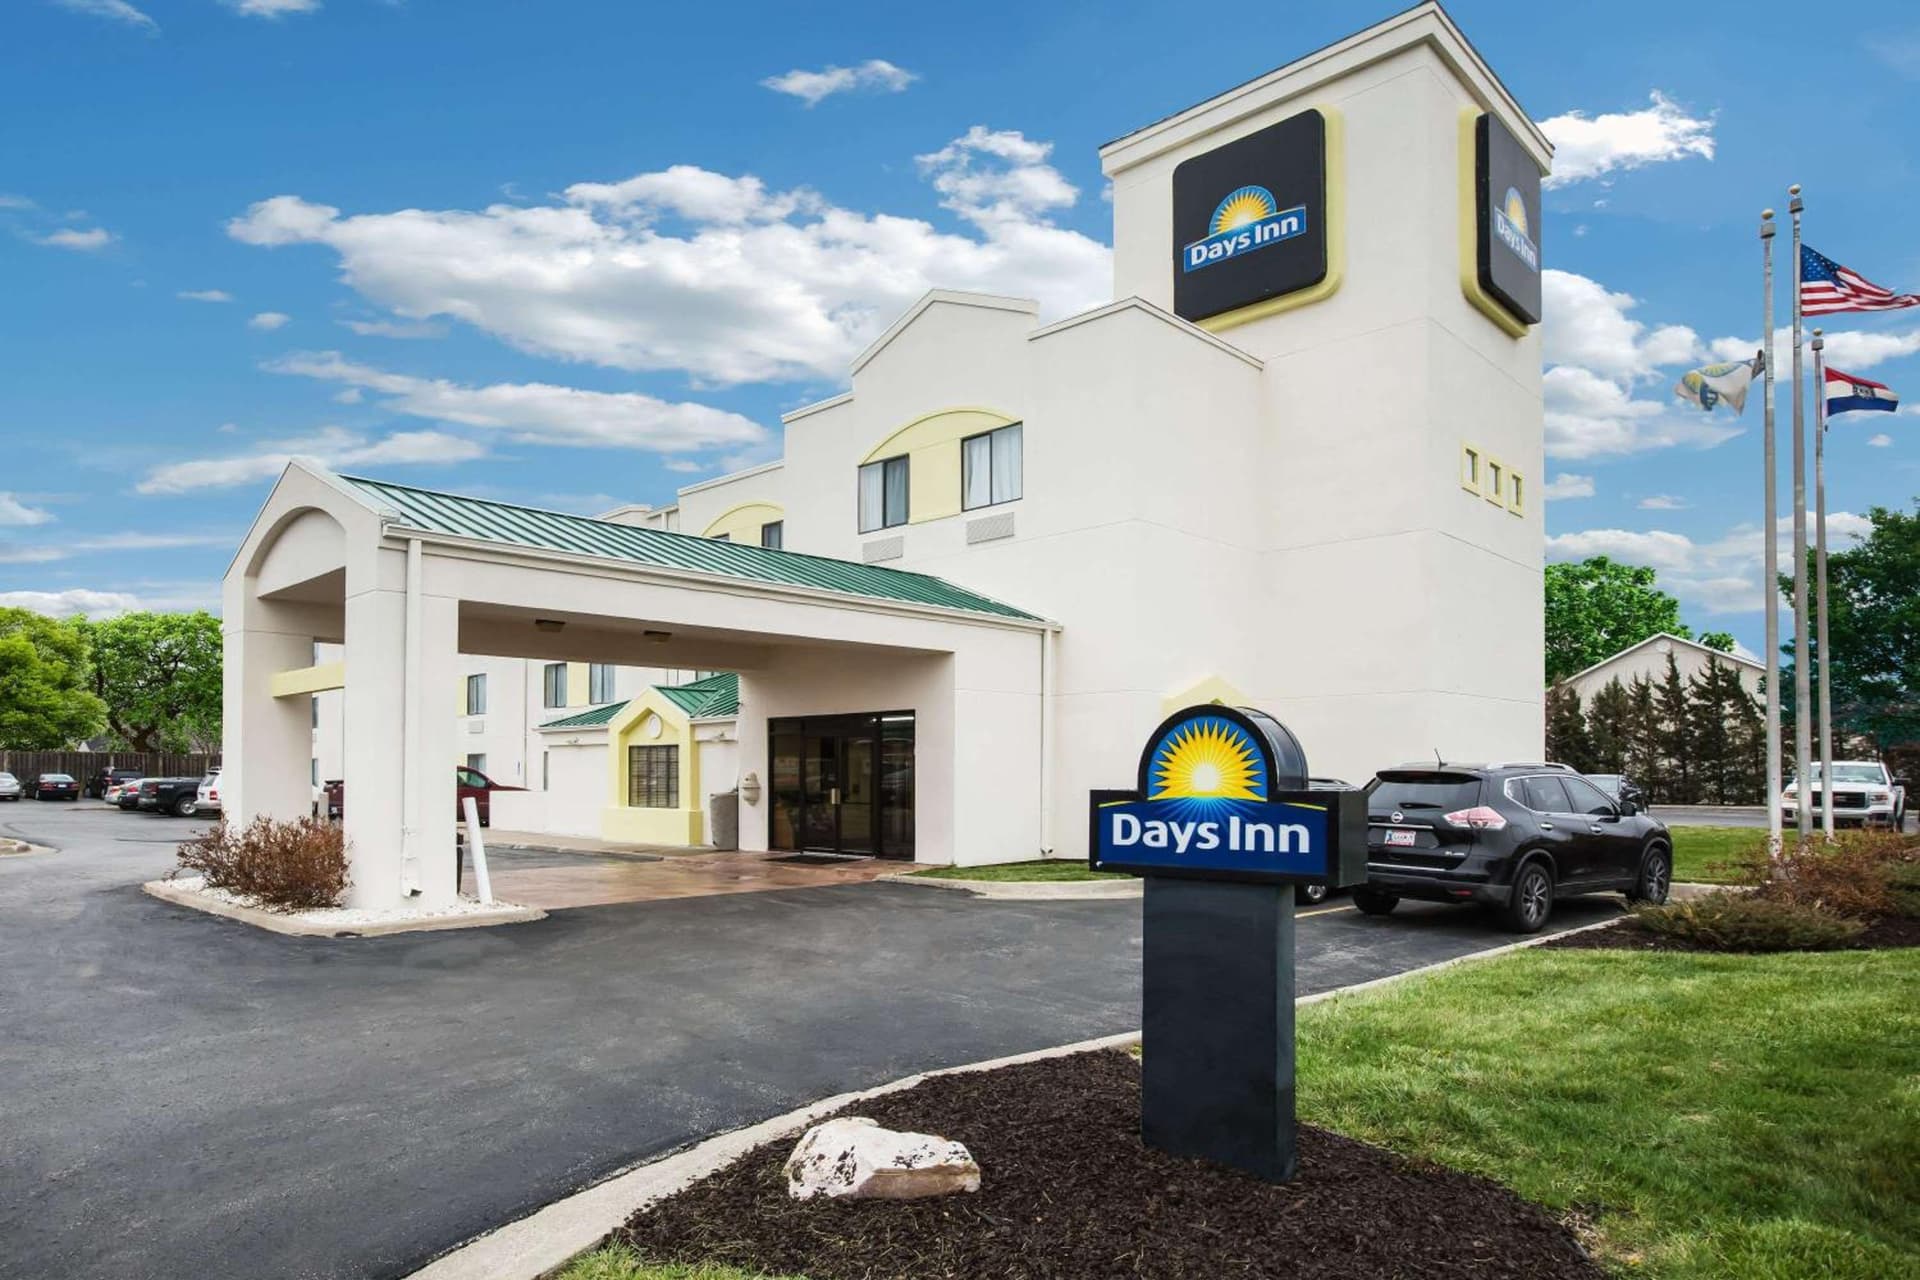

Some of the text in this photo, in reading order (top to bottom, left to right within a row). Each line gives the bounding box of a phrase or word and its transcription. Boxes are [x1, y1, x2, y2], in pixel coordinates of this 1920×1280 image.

[1190, 215, 1298, 266] Days Inn
[1497, 213, 1536, 266] Days Inn
[1112, 813, 1310, 854] Days Inn
